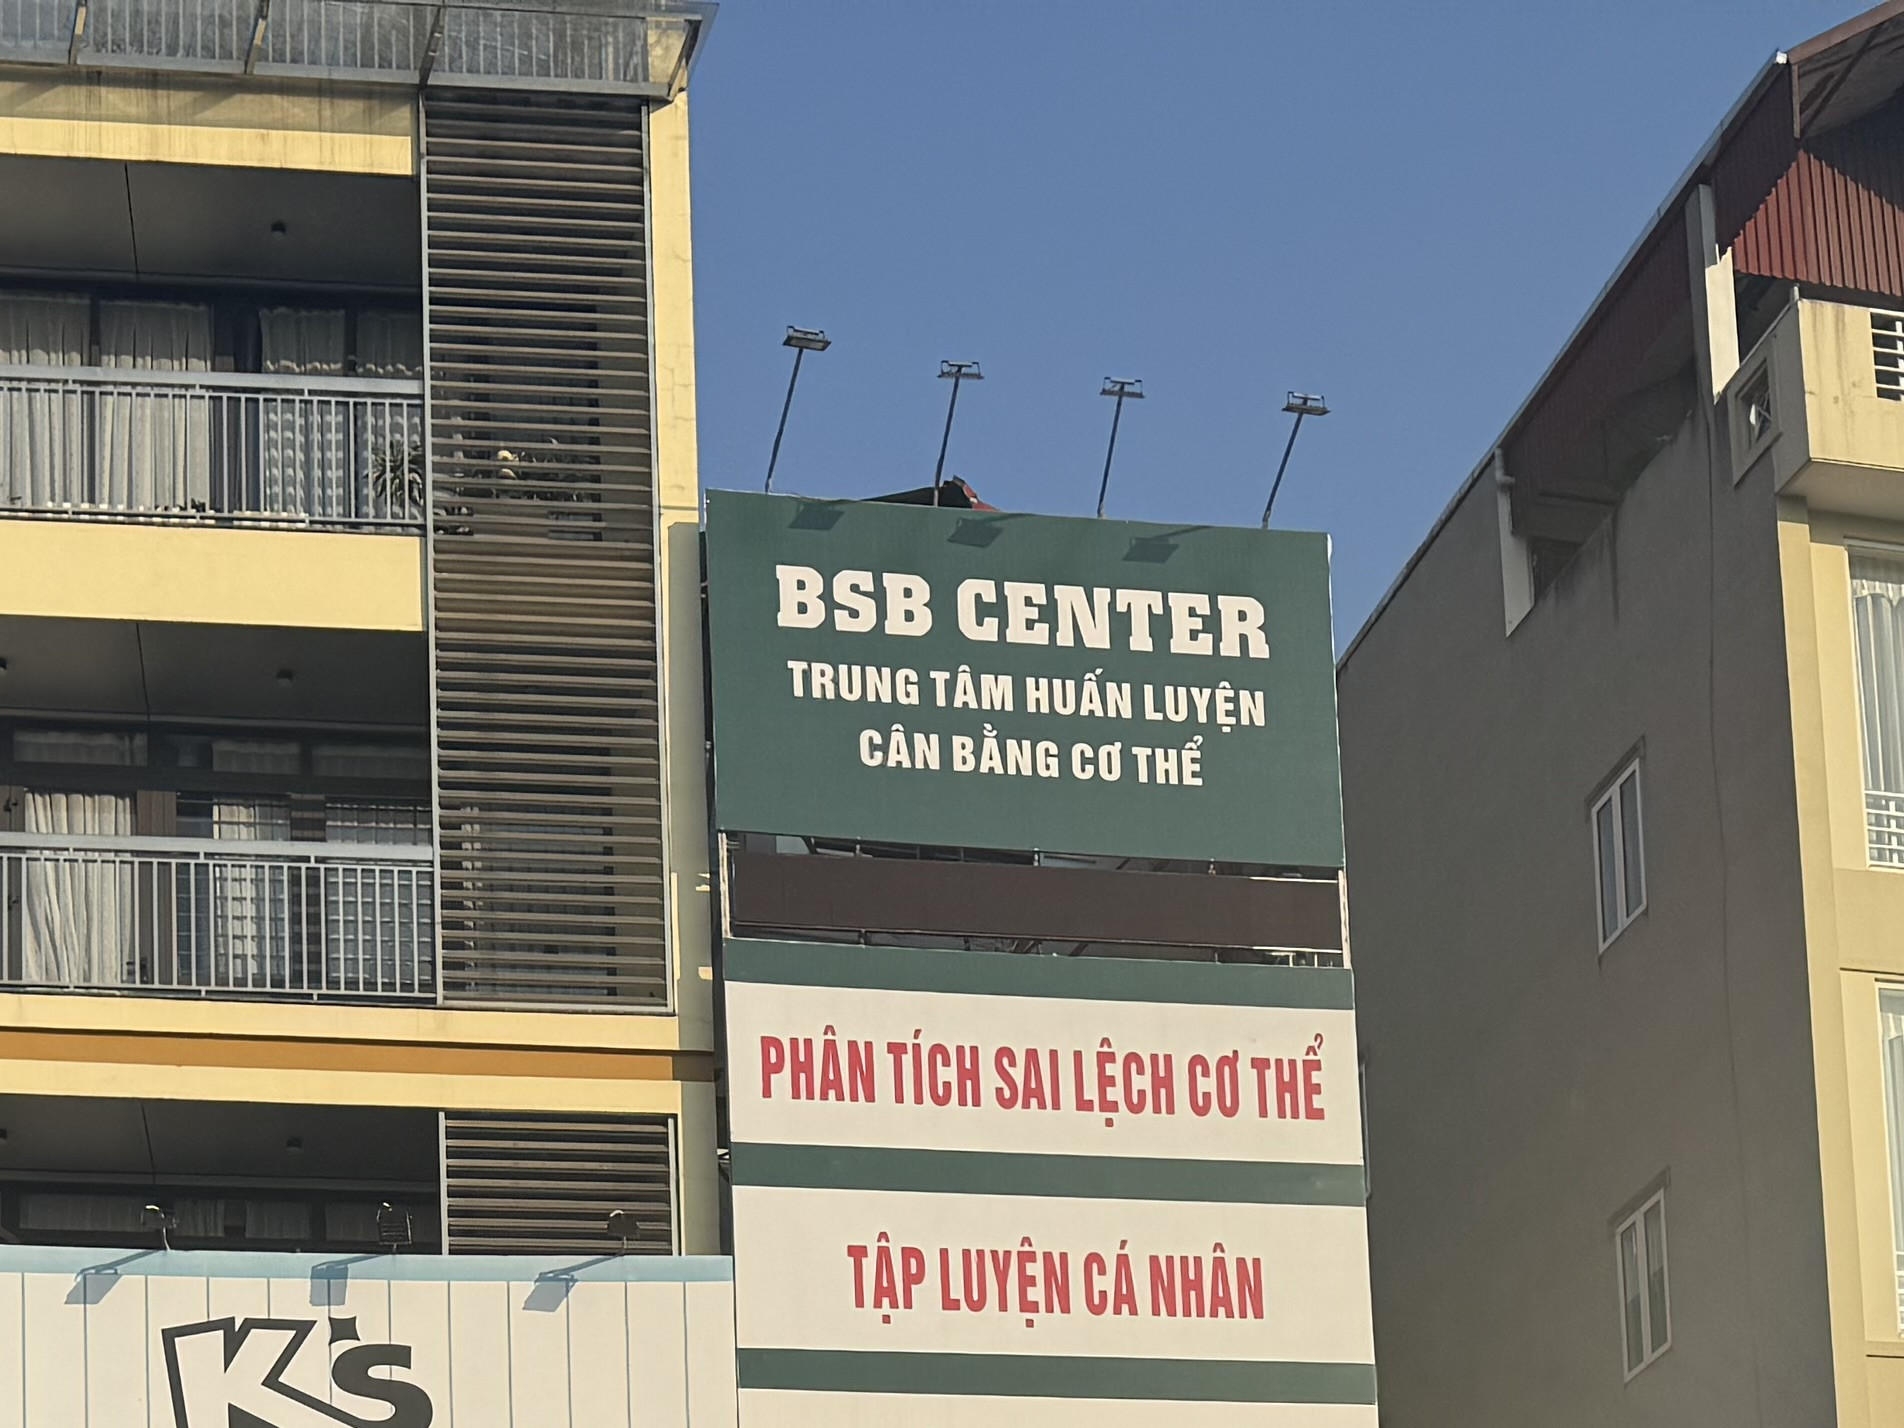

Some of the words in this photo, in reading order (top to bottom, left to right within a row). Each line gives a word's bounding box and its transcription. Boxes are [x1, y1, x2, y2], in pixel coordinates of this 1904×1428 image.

[776, 565, 932, 637] BSB
[957, 578, 1270, 659] CENTER
[787, 660, 919, 706] TRUNG
[930, 665, 1011, 713] TÂM
[1027, 667, 1132, 719] HUẤN
[1143, 681, 1265, 733] LUYỆN
[860, 724, 940, 770] CÂN
[953, 723, 1059, 778] BẰNG
[1072, 743, 1122, 783] CƠ
[1132, 734, 1203, 786] THỂ
[760, 1024, 876, 1104] PHÂN
[887, 1028, 980, 1107] TÍCH
[994, 1046, 1062, 1111] SAI
[1074, 1037, 1175, 1128] LỆCH
[1187, 1049, 1240, 1118] CƠ
[1250, 1032, 1325, 1121] THỂ
[847, 1231, 926, 1325] TẬP
[939, 1236, 1070, 1329] LUYỆN
[1083, 1239, 1137, 1317] CÁ
[1149, 1242, 1264, 1320] NHÂN
